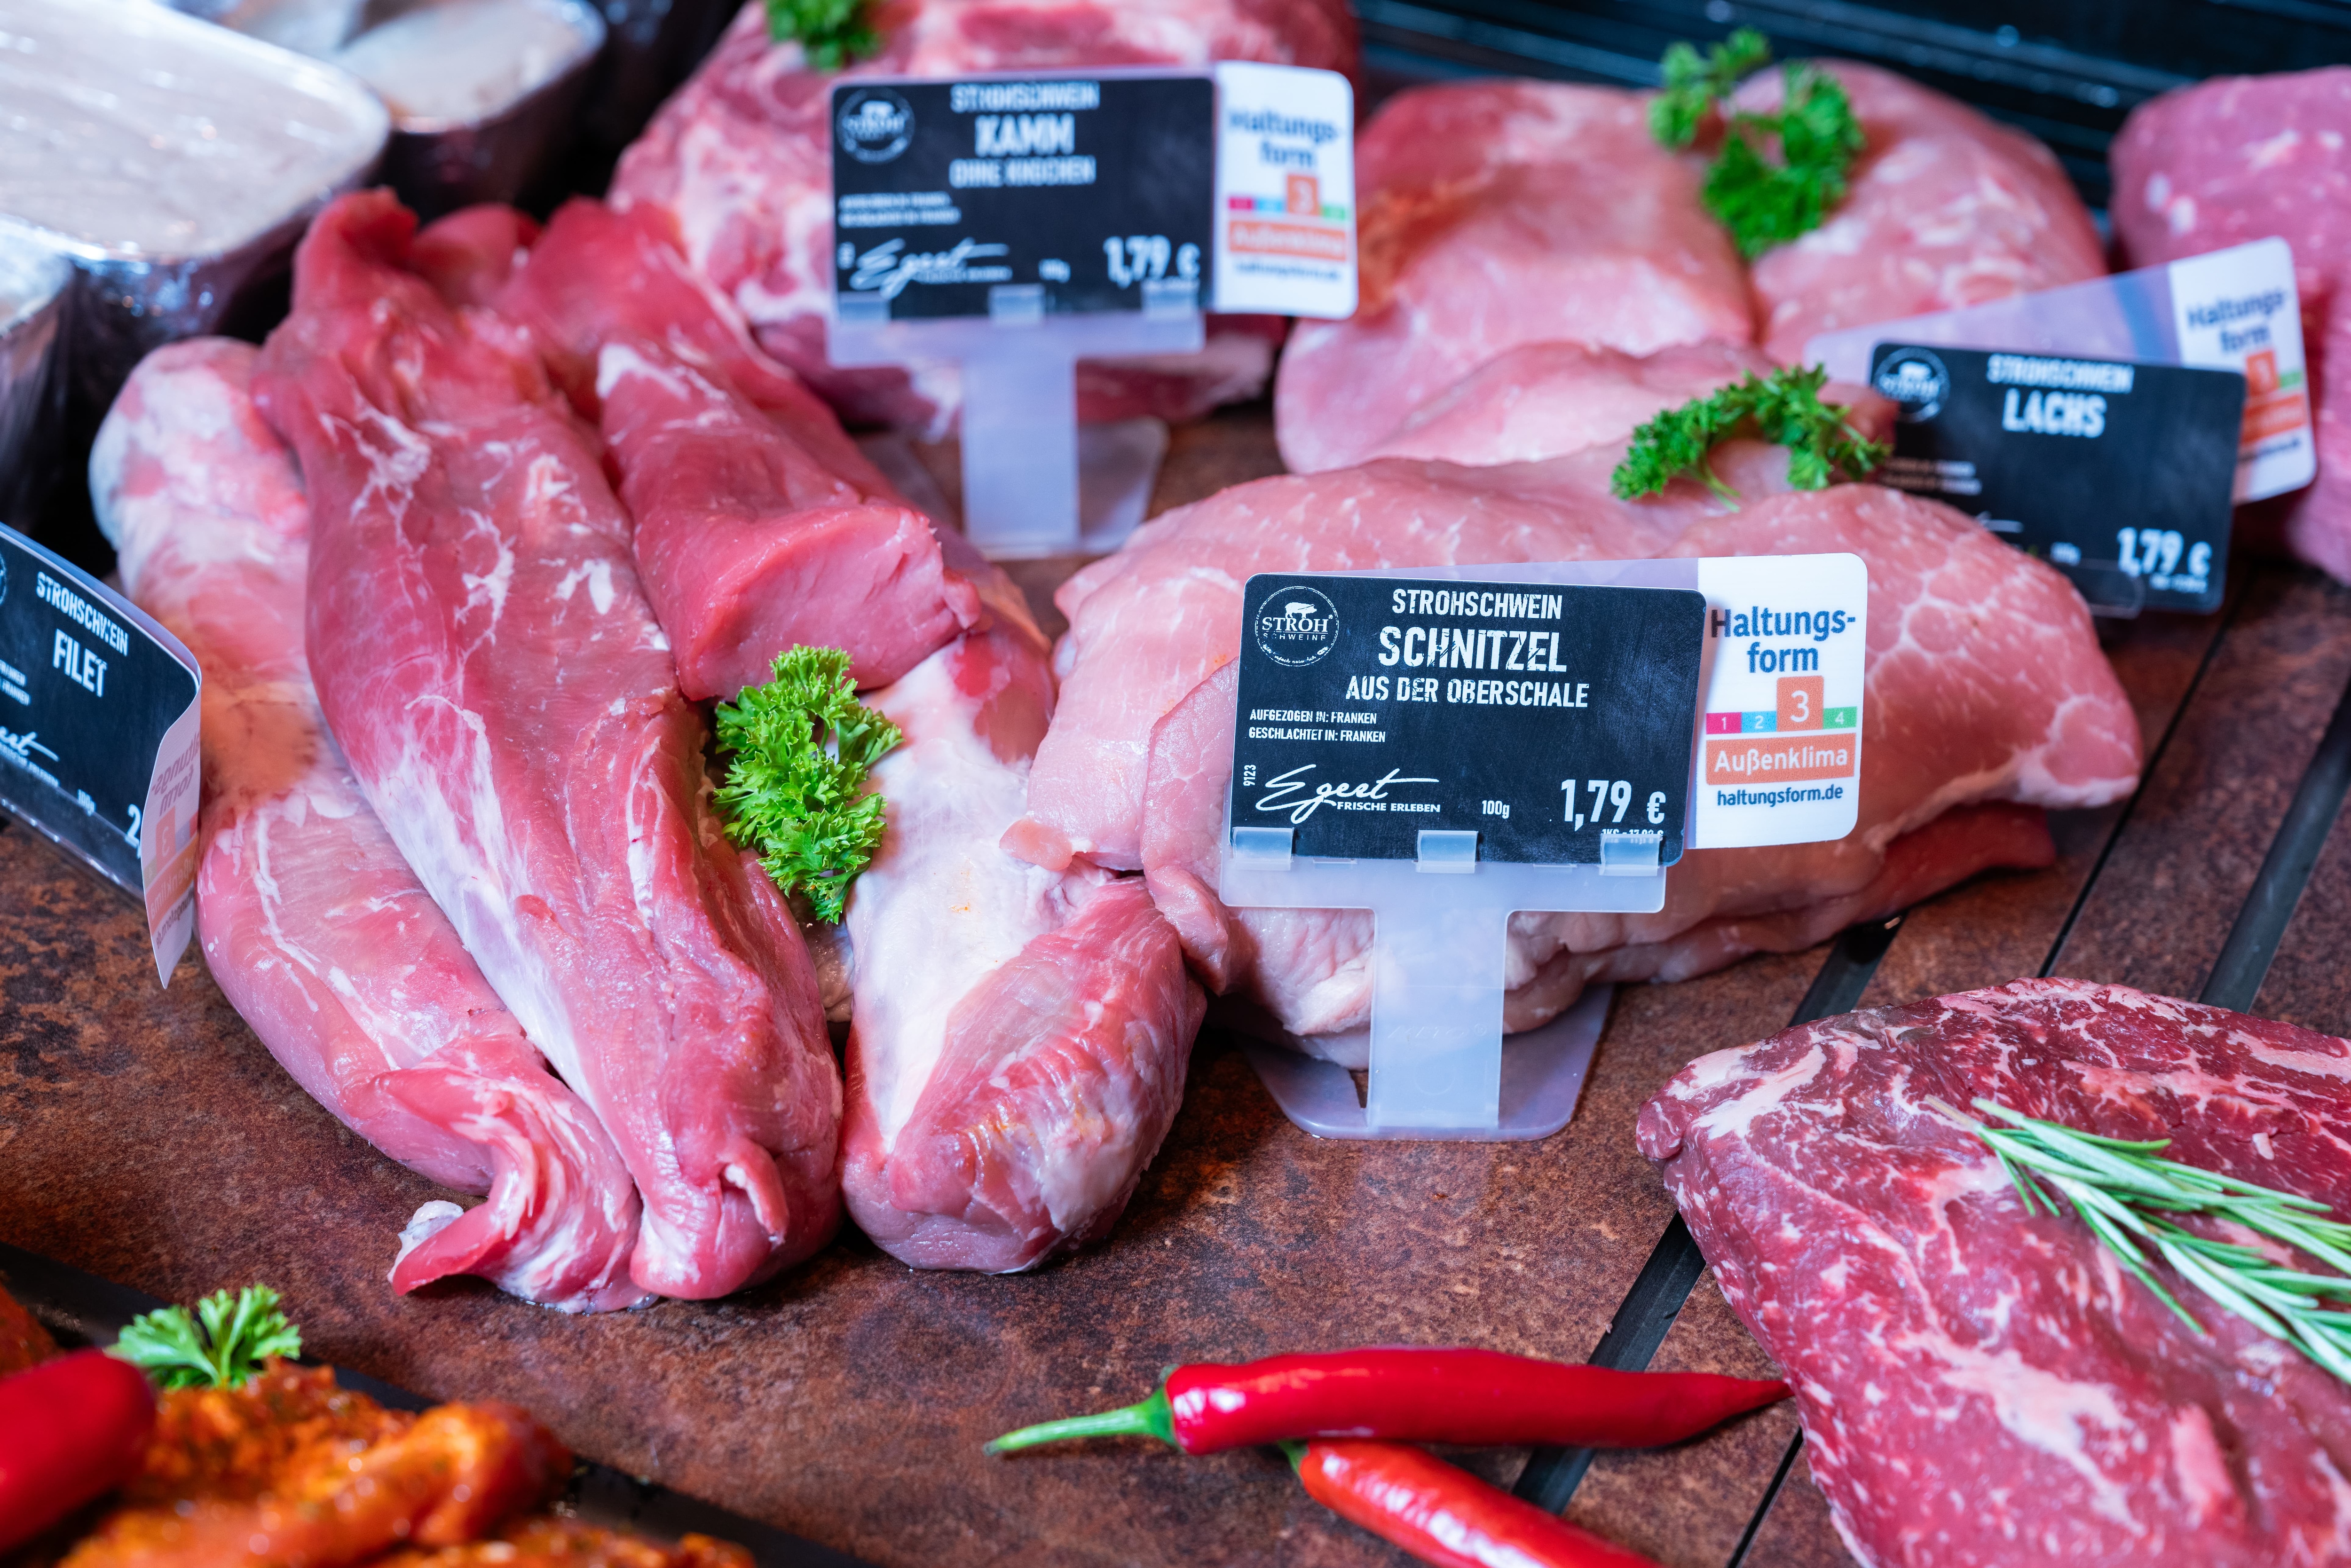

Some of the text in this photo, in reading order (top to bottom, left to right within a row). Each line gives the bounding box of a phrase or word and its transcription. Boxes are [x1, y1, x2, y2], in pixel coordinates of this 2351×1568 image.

[975, 113, 1075, 158] KAMM
[1103, 235, 1200, 289] 1,79 €
[2002, 387, 2107, 438] LACHS
[2117, 526, 2212, 578] 1,79 €
[1392, 589, 1562, 619] STROHSCHWEIN
[1262, 617, 1329, 632] STROH
[1710, 606, 1855, 642] Haltungs-
[53, 628, 108, 698] FILET
[1379, 626, 1567, 672] SCHNITZEL
[1747, 641, 1819, 673] form
[1345, 675, 1589, 708] AUS DER OBERSCHALE
[1249, 709, 1377, 724] AUFGEZOGEN IN: FRANKEN
[1721, 690, 1845, 731] 1 2 3 4
[1249, 726, 1386, 742] GESCHLACHTET IN: FRANKEN
[1243, 764, 1256, 787] 9123
[1714, 745, 1848, 775] Außenklima
[1337, 801, 1441, 813] FRISCHE ERLEBEN
[1482, 800, 1510, 819] 100g
[1561, 779, 1666, 832] 1,79 €
[1717, 784, 1843, 807] haltungsform.de
